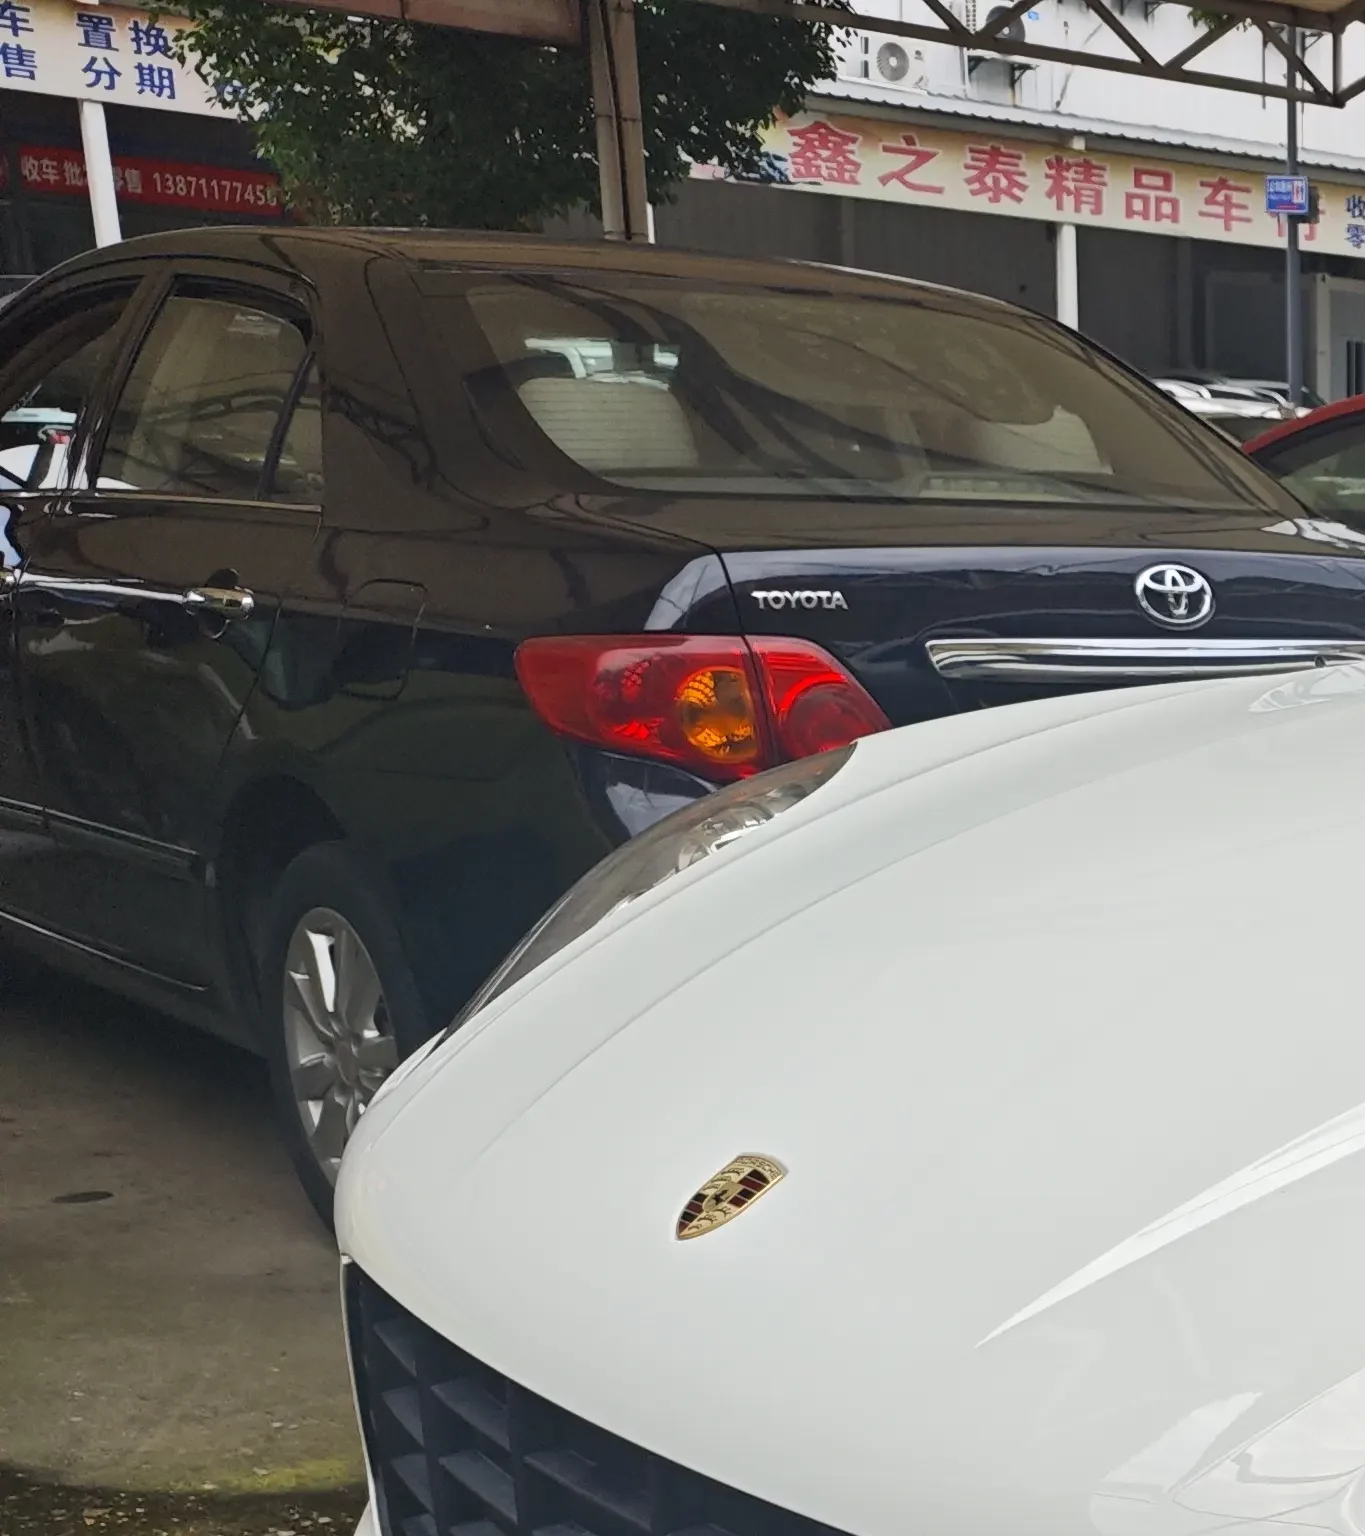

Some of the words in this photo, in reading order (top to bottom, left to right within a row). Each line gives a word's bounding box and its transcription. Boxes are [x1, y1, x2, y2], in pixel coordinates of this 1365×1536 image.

[76, 12, 177, 60] 置换
[0, 42, 37, 81] 售
[81, 56, 176, 100] 分期
[750, 590, 849, 610] TOYOTA
